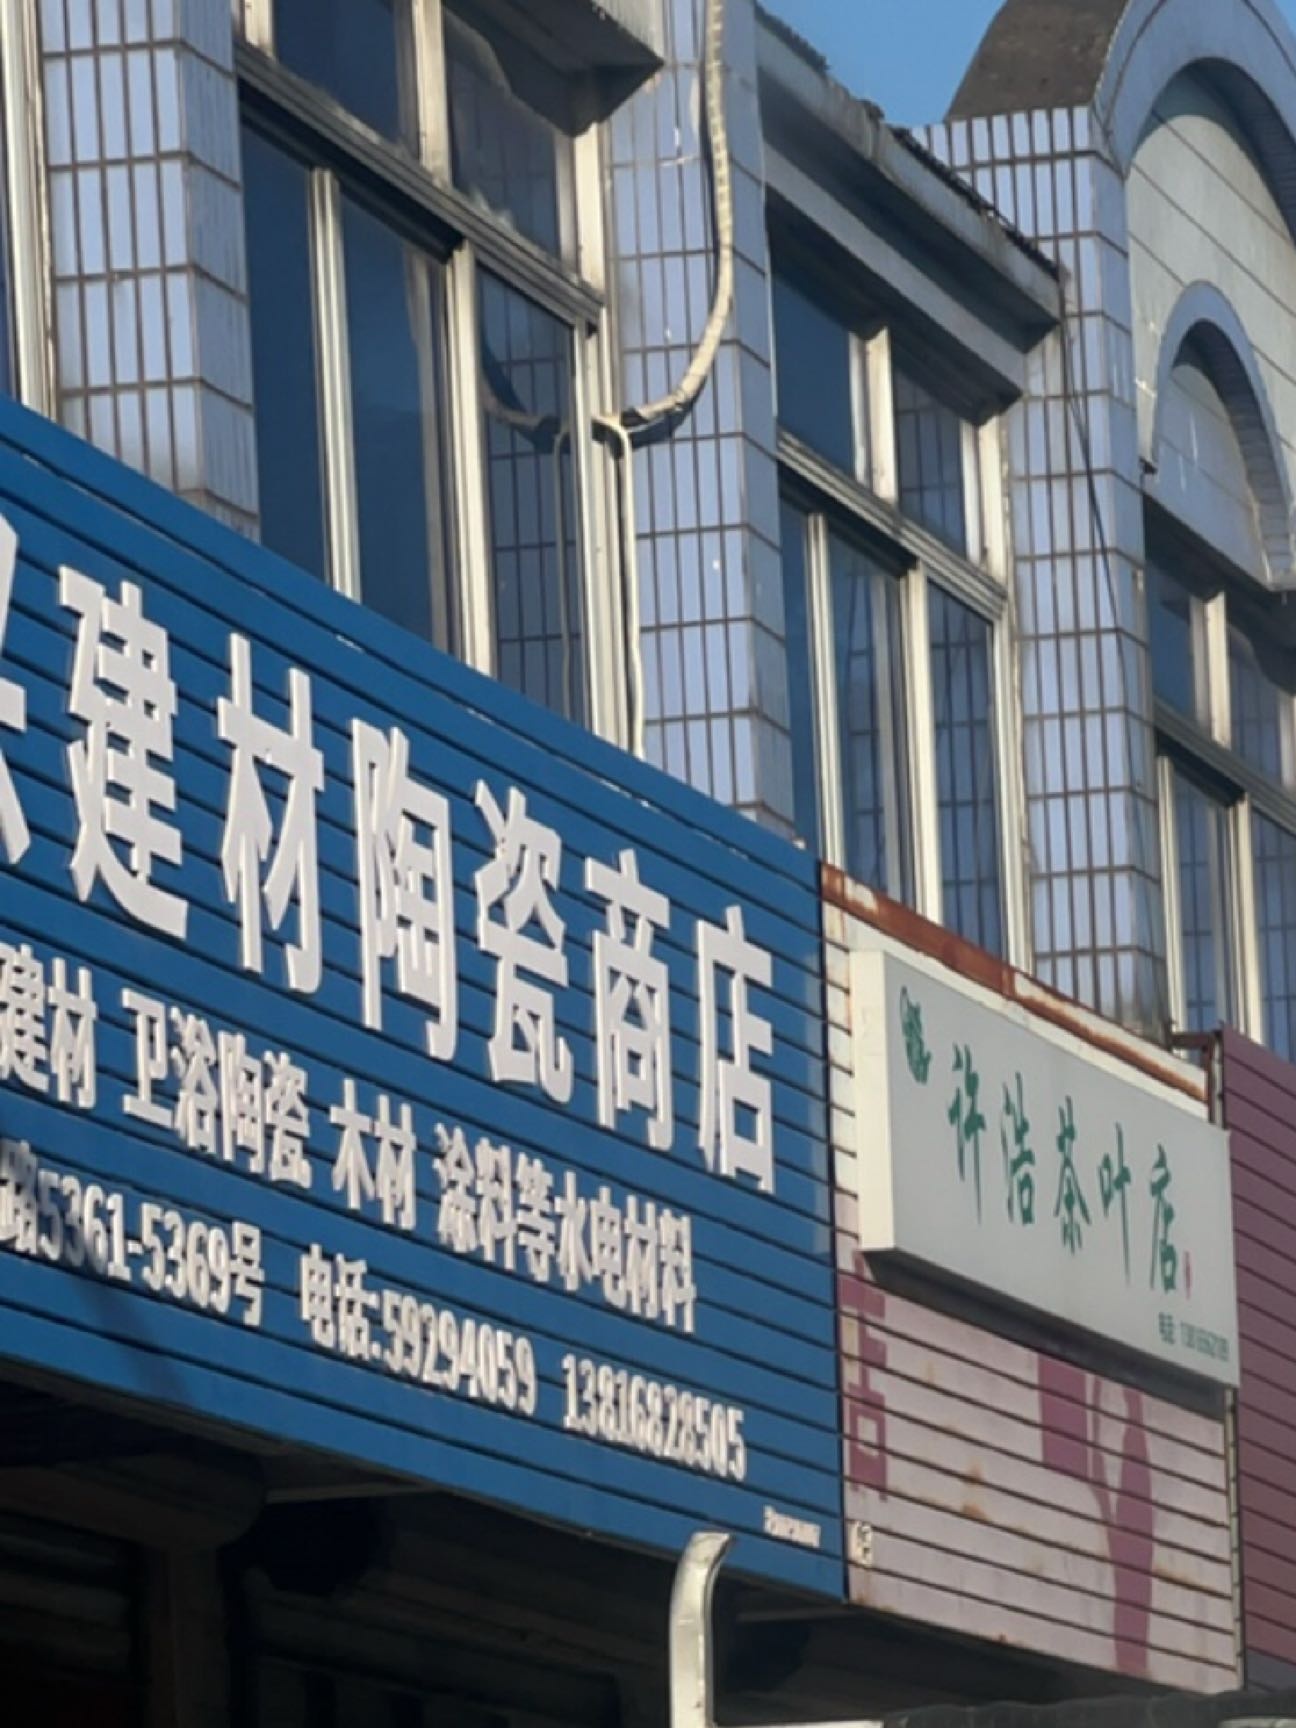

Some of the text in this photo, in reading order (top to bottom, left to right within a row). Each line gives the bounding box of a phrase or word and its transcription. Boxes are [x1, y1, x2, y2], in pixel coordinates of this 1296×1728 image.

[122, 988, 312, 1190] 卫浴陶瓷
[330, 1079, 417, 1230] 木材
[433, 1123, 697, 1334] 涂料等水电材料
